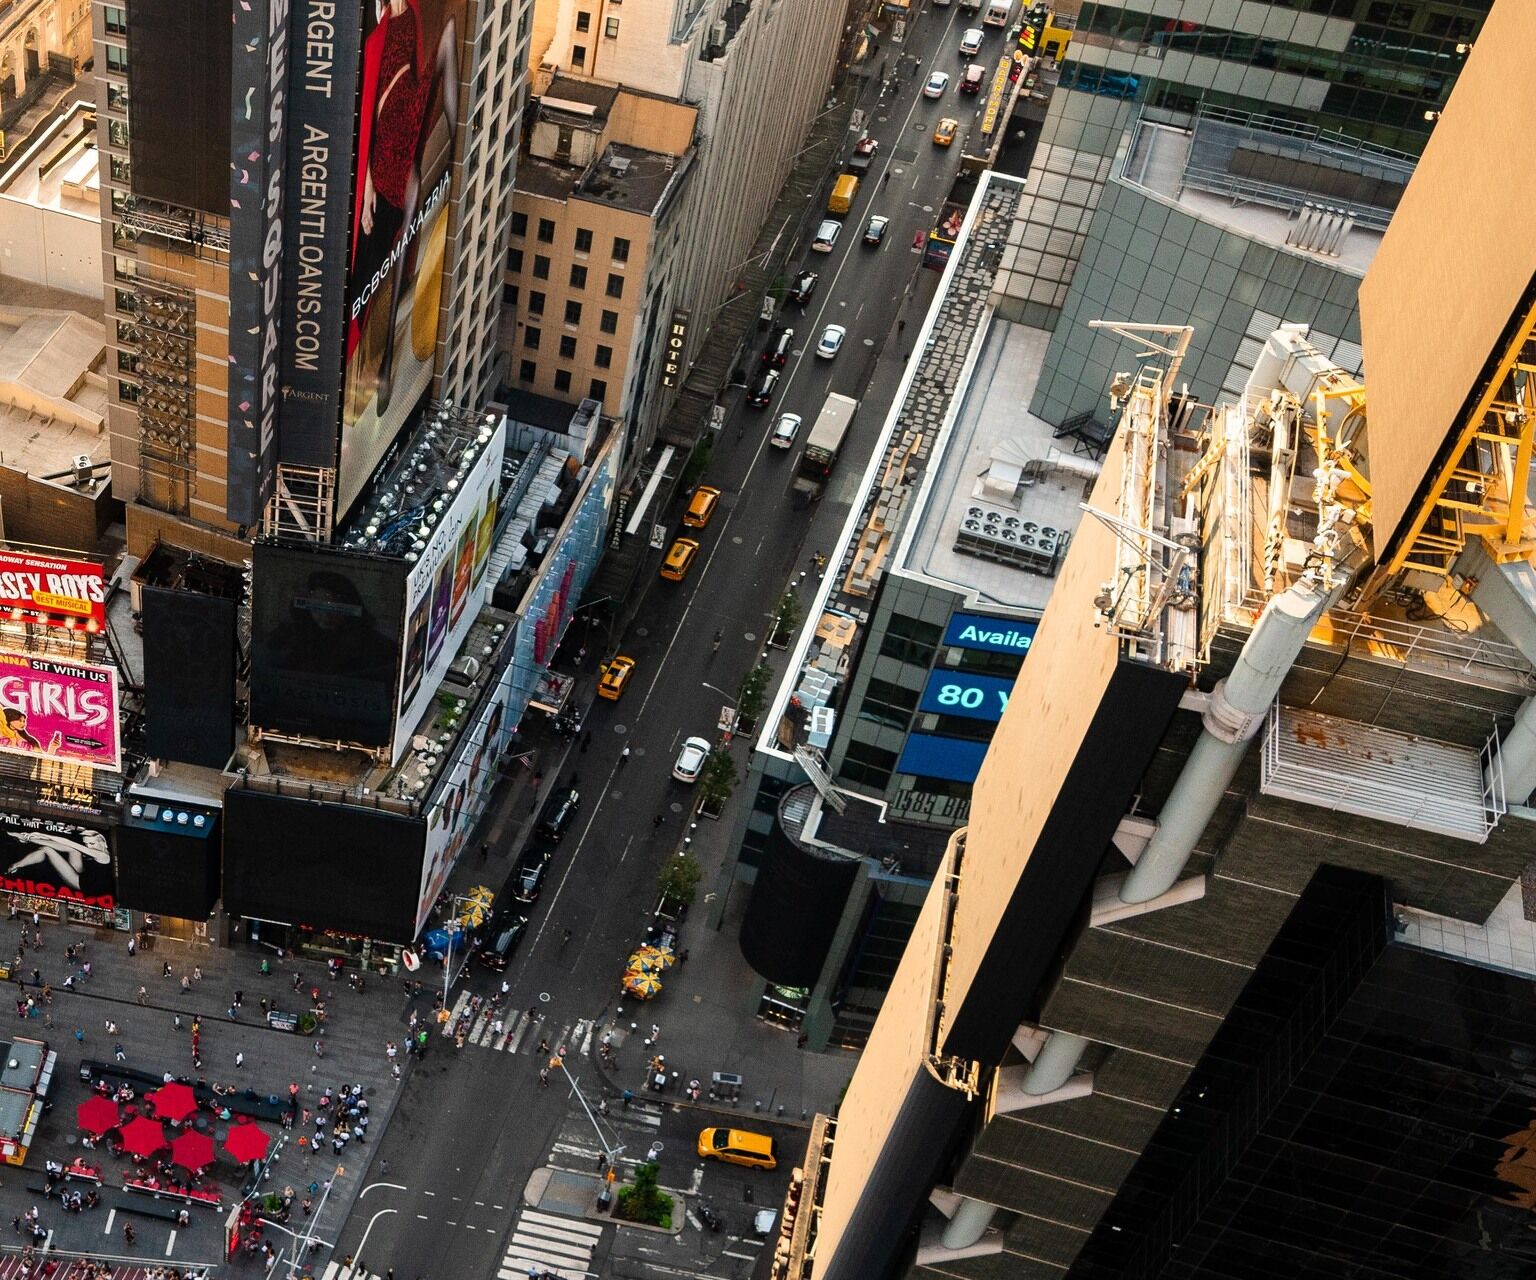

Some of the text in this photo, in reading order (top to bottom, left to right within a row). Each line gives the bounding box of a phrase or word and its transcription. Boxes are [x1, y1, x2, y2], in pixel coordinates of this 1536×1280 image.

[294, 122, 329, 372] ARGENTLOANS.COM
[351, 170, 451, 321] BCBGMAXAZRIA
[260, 168, 283, 458] SQUARE
[663, 324, 686, 387] HOTEL
[25, 560, 67, 571] SENSATION
[46, 573, 105, 603] BOYS
[36, 594, 55, 605] BEST
[56, 599, 89, 611] MUSICAL
[959, 625, 1032, 649] Availa
[32, 660, 51, 671] SIT
[54, 664, 86, 678] WITH
[937, 685, 984, 708] 80
[892, 790, 937, 813] 1585
